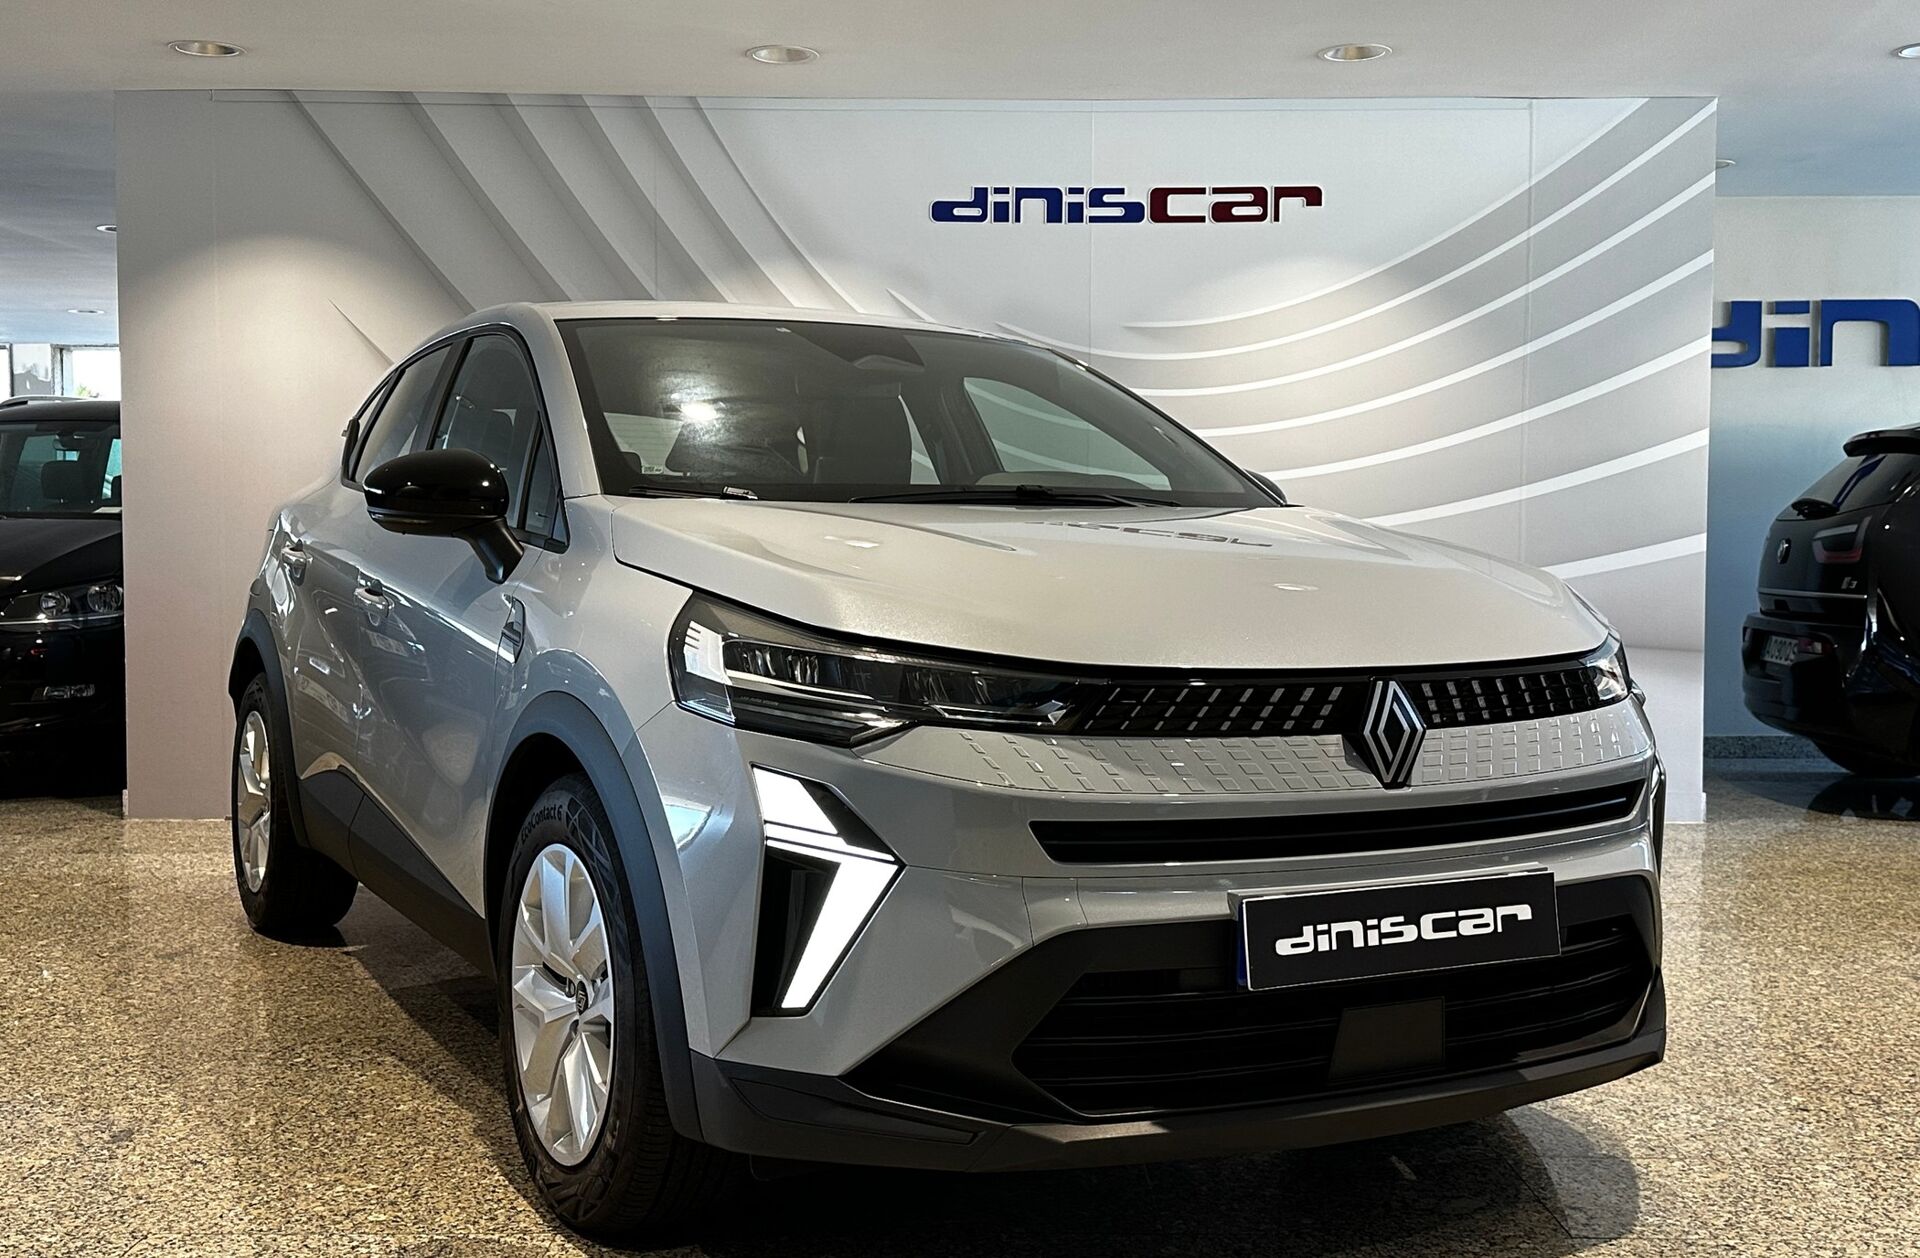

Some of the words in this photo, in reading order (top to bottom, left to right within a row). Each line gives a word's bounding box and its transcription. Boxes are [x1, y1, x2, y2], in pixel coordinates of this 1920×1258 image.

[930, 186, 1323, 224] diniscar
[520, 804, 557, 842] EcoContact
[557, 804, 563, 822] 6
[1275, 904, 1533, 956] diniscar
